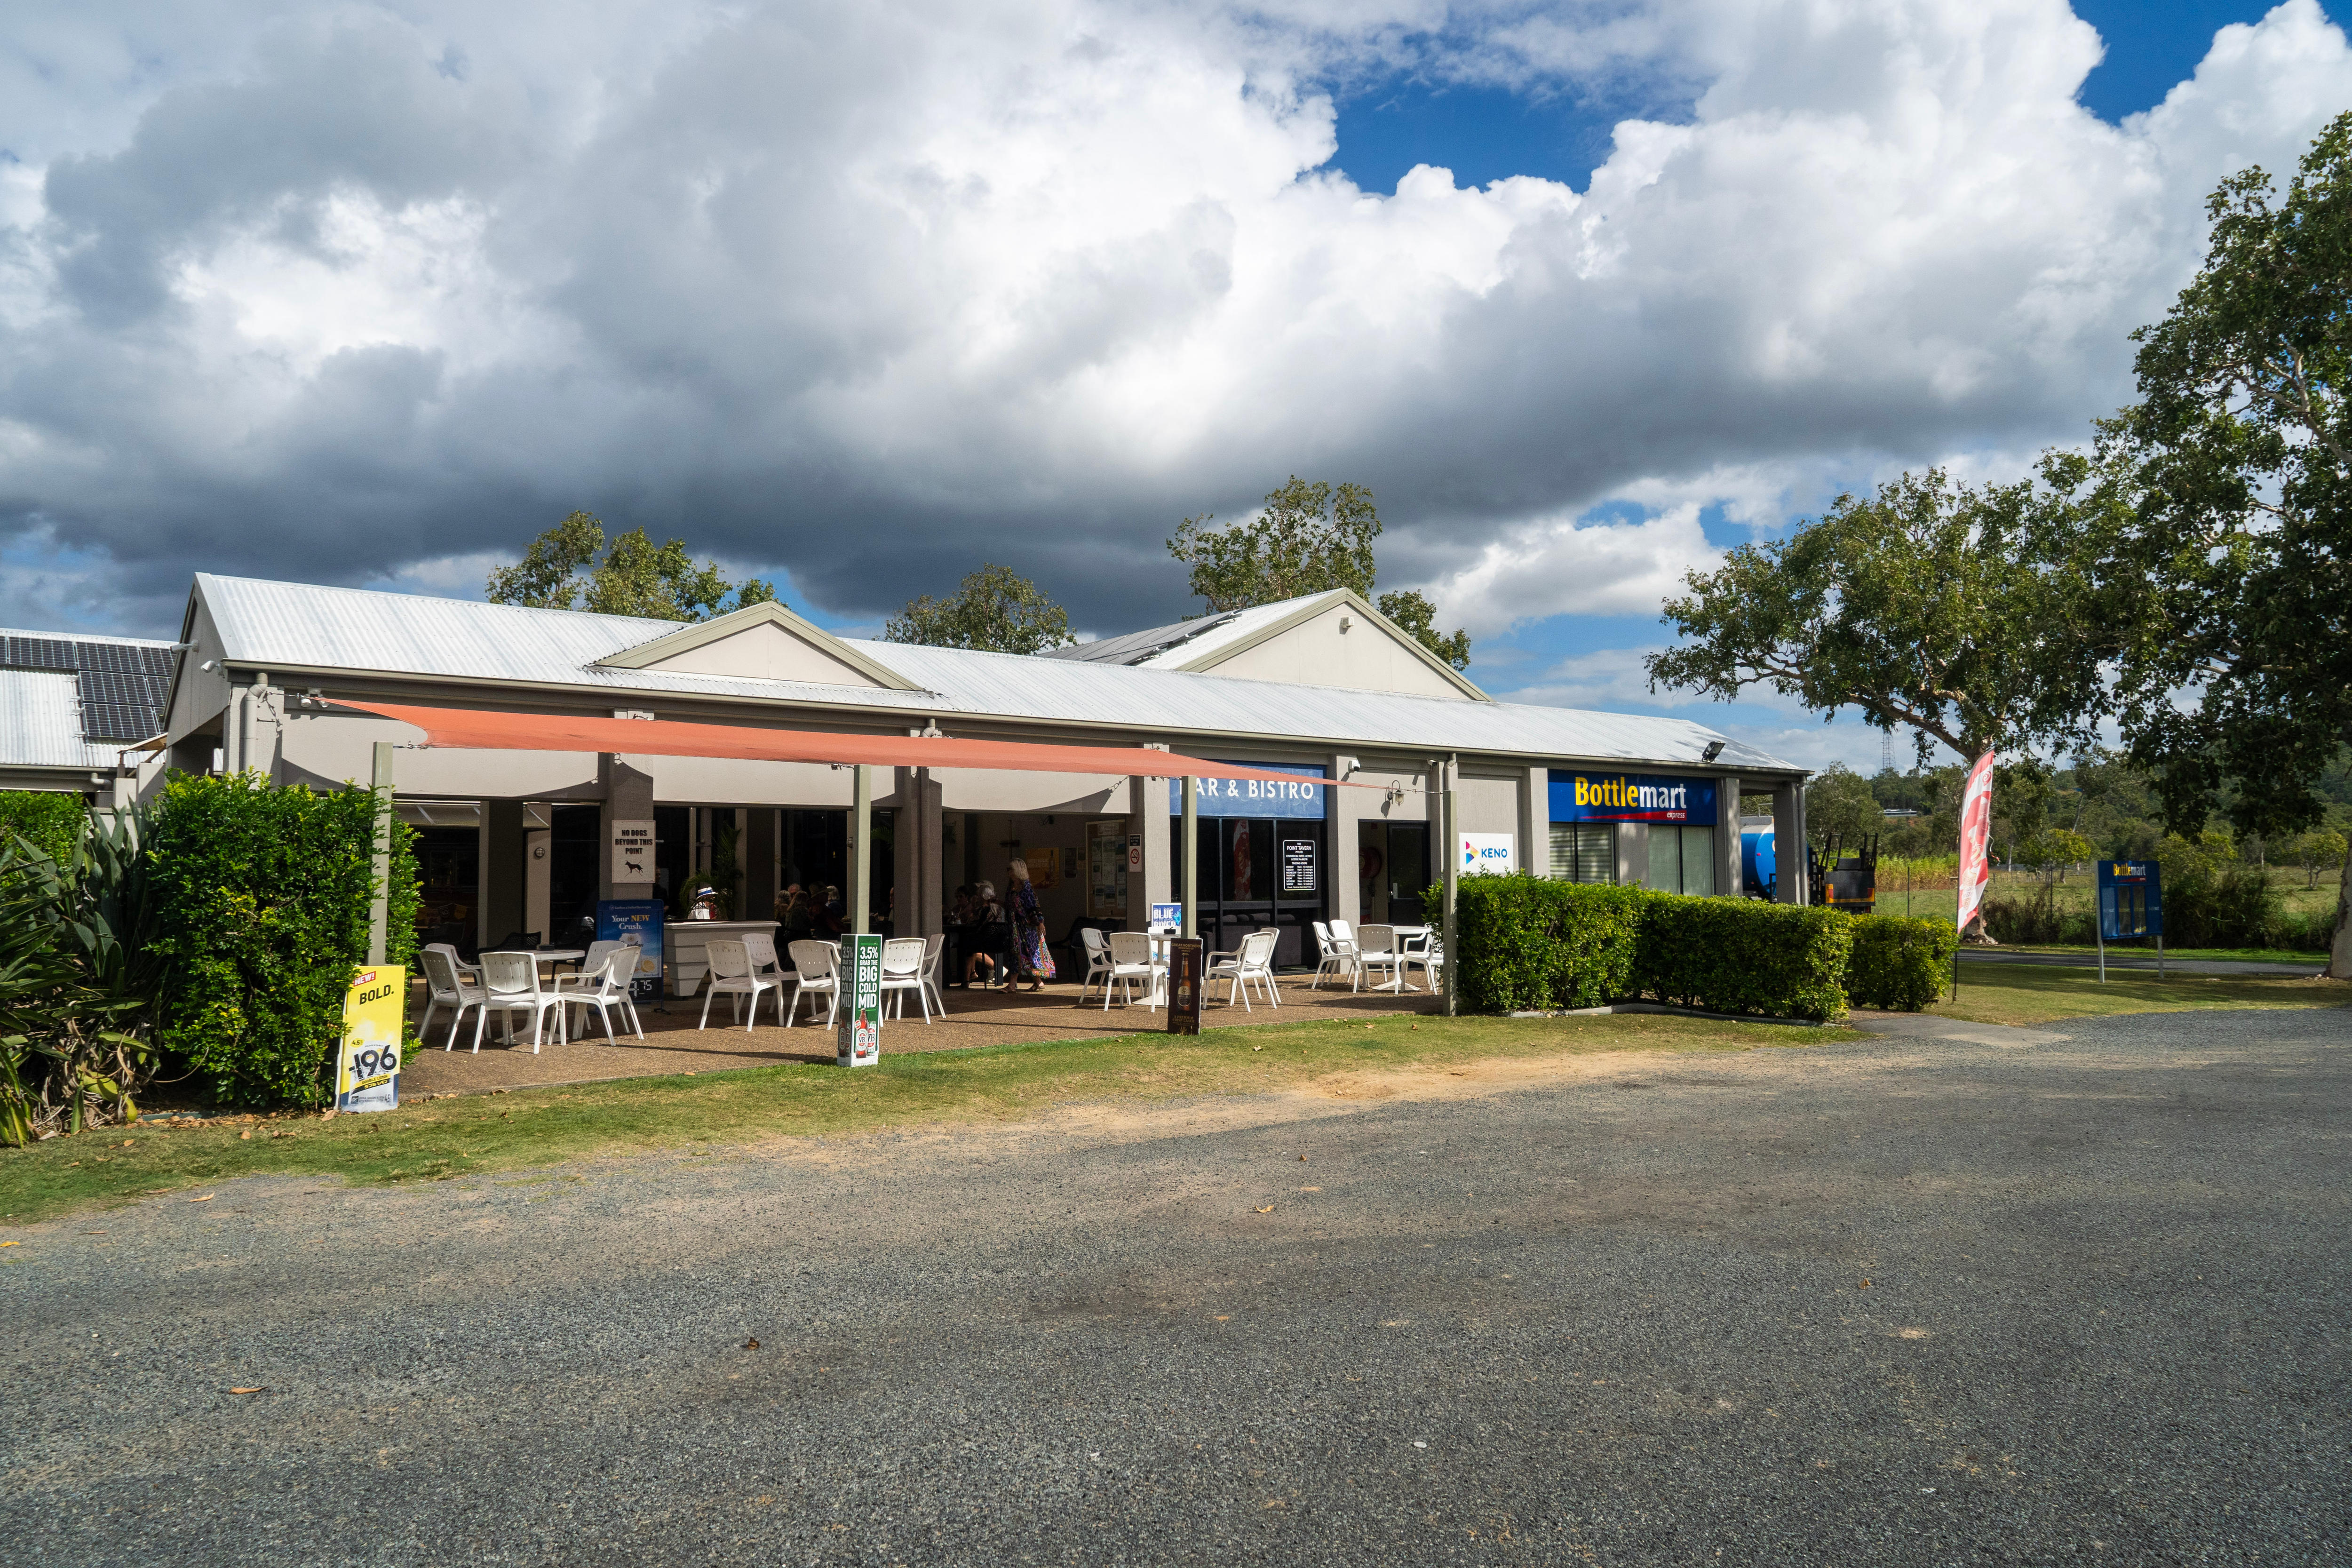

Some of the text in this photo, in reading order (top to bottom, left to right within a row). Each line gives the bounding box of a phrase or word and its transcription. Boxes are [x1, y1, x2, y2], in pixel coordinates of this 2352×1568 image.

[1180, 777, 1314, 799] AR & BISTRO
[1575, 776, 1687, 809] Bottlemart
[1667, 811, 1685, 820] express
[1481, 848, 1508, 858] KENO
[2113, 862, 2146, 876] Bottlemart
[1153, 907, 1174, 919] BLUE
[842, 946, 853, 959] 3.5%
[860, 946, 878, 959] 3.5%
[355, 972, 375, 986] NEW!
[842, 966, 852, 982] BIG
[859, 966, 878, 982] BIG
[359, 984, 394, 1005] BOLD.
[841, 982, 852, 993] COLD
[858, 982, 877, 993] COLD
[841, 993, 851, 1008] MID
[858, 993, 877, 1008] MID
